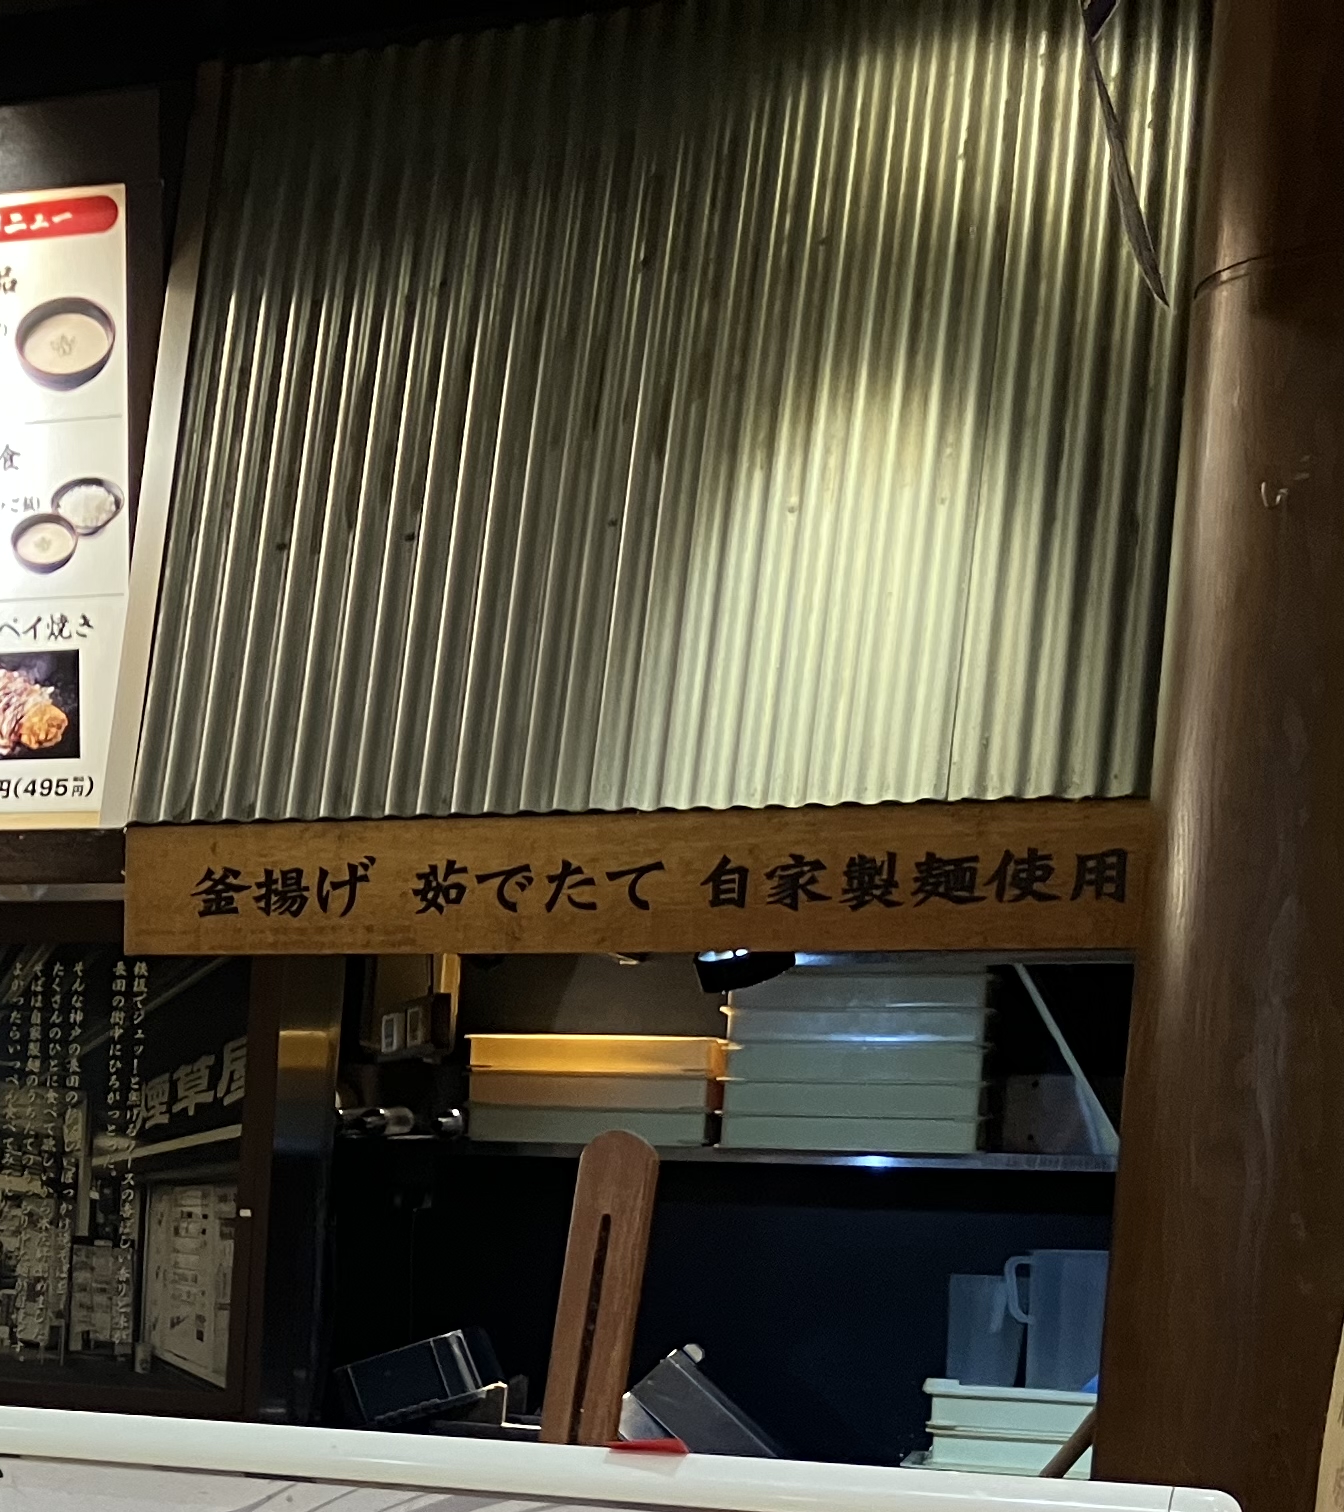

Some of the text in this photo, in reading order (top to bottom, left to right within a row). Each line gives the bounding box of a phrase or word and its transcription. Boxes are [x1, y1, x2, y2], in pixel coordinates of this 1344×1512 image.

[189, 845, 1131, 921] 釜揚げ 茹でたて 自家製麺使用
